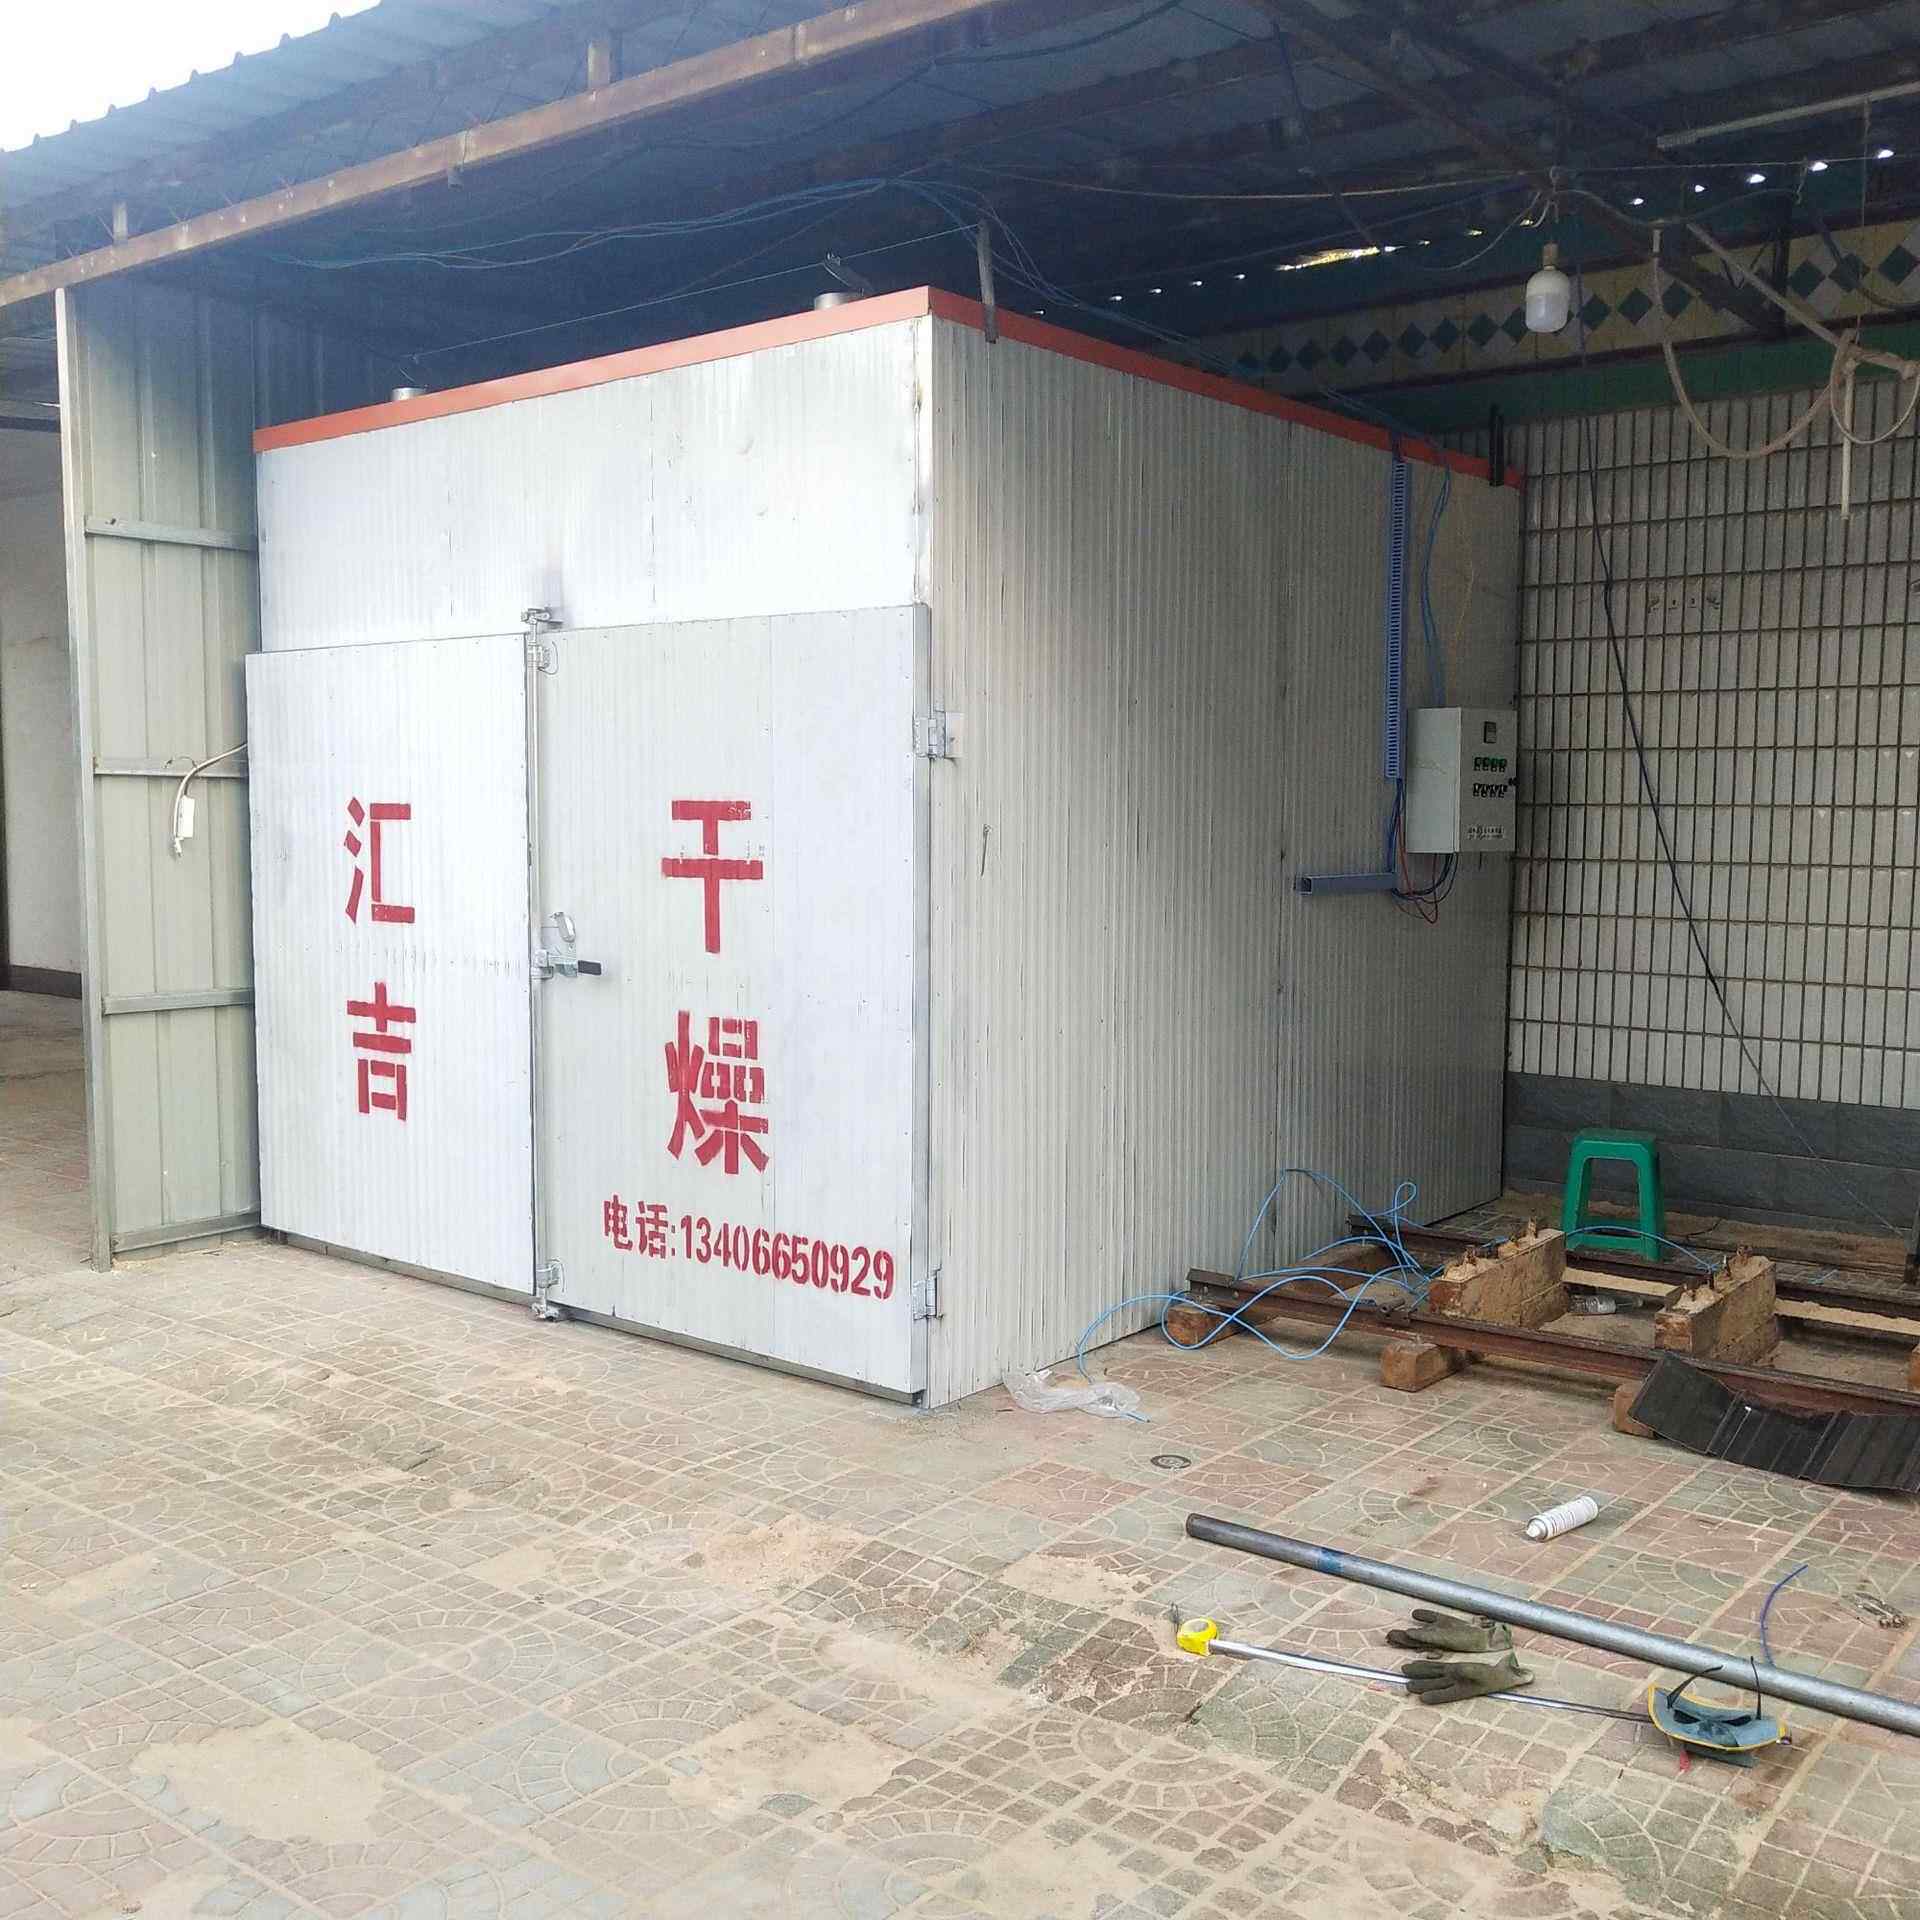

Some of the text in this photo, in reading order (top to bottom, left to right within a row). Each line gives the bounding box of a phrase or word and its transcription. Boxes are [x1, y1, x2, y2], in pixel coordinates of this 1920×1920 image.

[344, 797, 417, 1122] 汇吉
[661, 800, 770, 1175] 干燥
[603, 1195, 895, 1300] 电话:13406650929
